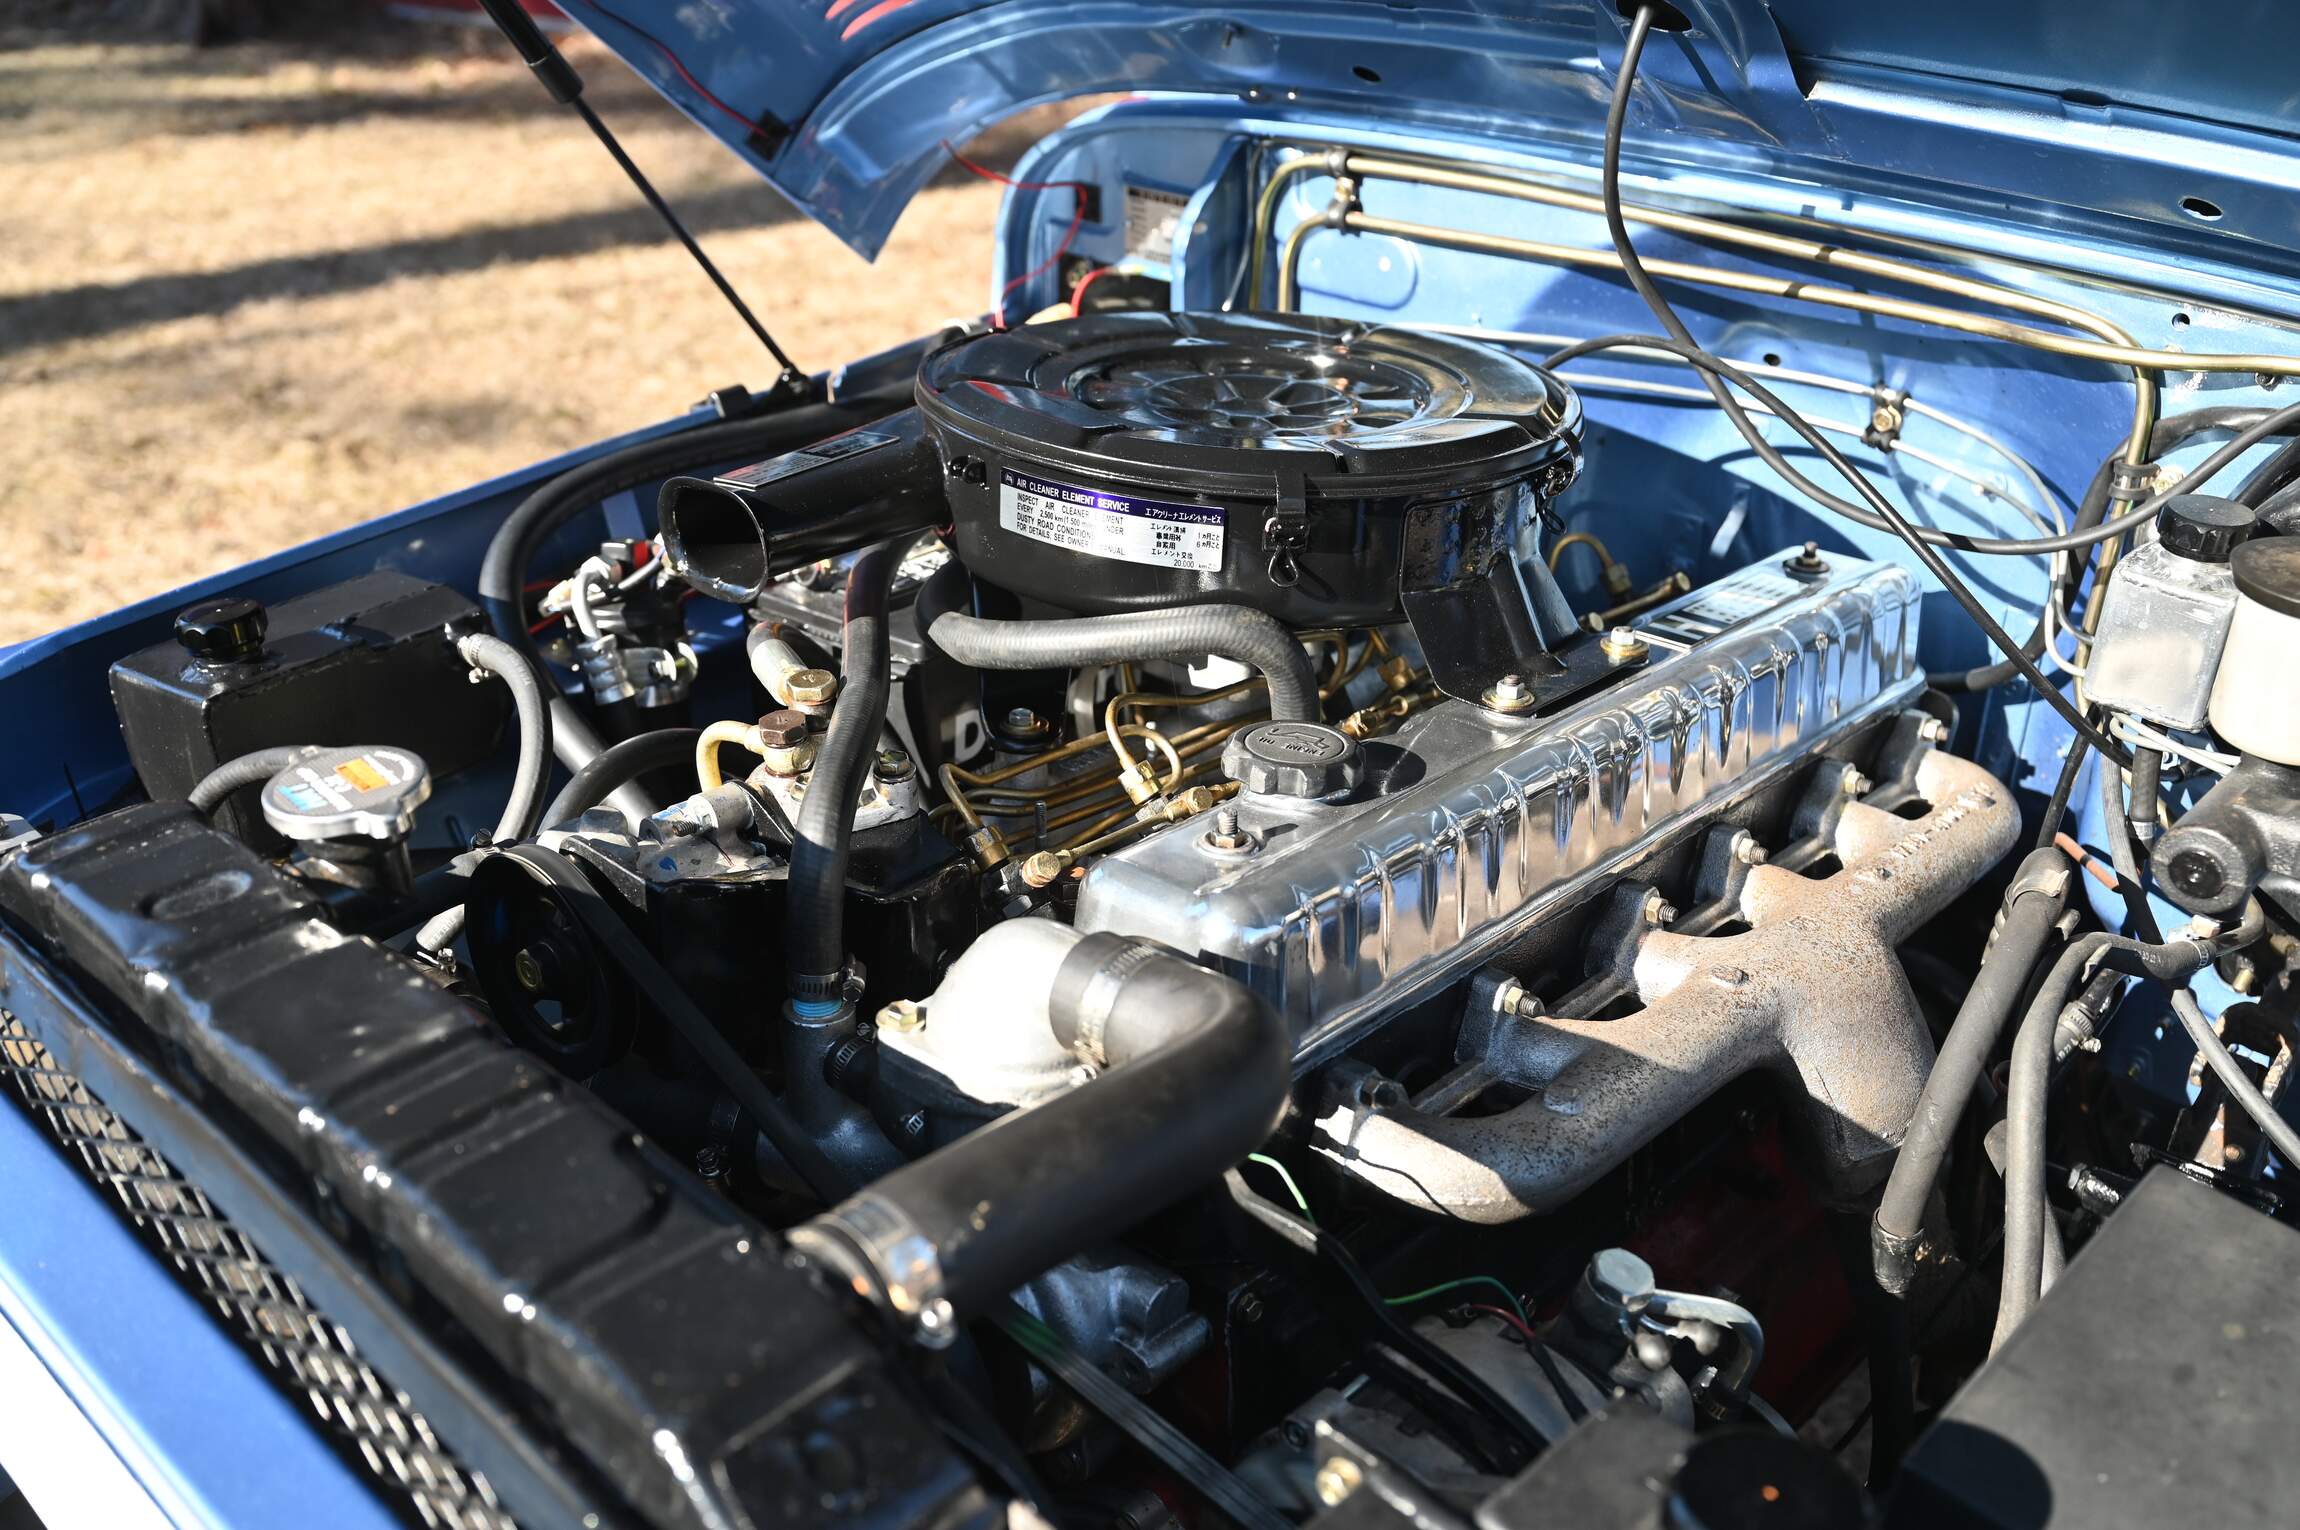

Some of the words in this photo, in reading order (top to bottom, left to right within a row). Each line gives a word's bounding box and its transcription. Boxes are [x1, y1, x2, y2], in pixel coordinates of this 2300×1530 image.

[1016, 478, 1027, 489] AIR
[1029, 481, 1060, 498] CLEANER
[1062, 490, 1096, 506] ELEMENT
[1097, 497, 1130, 513] SERVICE
[1017, 492, 1039, 507] INSPECT
[1045, 501, 1055, 511] AIR
[1061, 505, 1090, 518] CLEANER
[1017, 502, 1034, 514] EVERY
[1016, 512, 1035, 525] DUSTY
[1037, 518, 1055, 531] ROAD
[1016, 521, 1028, 532] FOR
[1053, 532, 1065, 543] SEE
[1257, 736, 1276, 746] OIL
